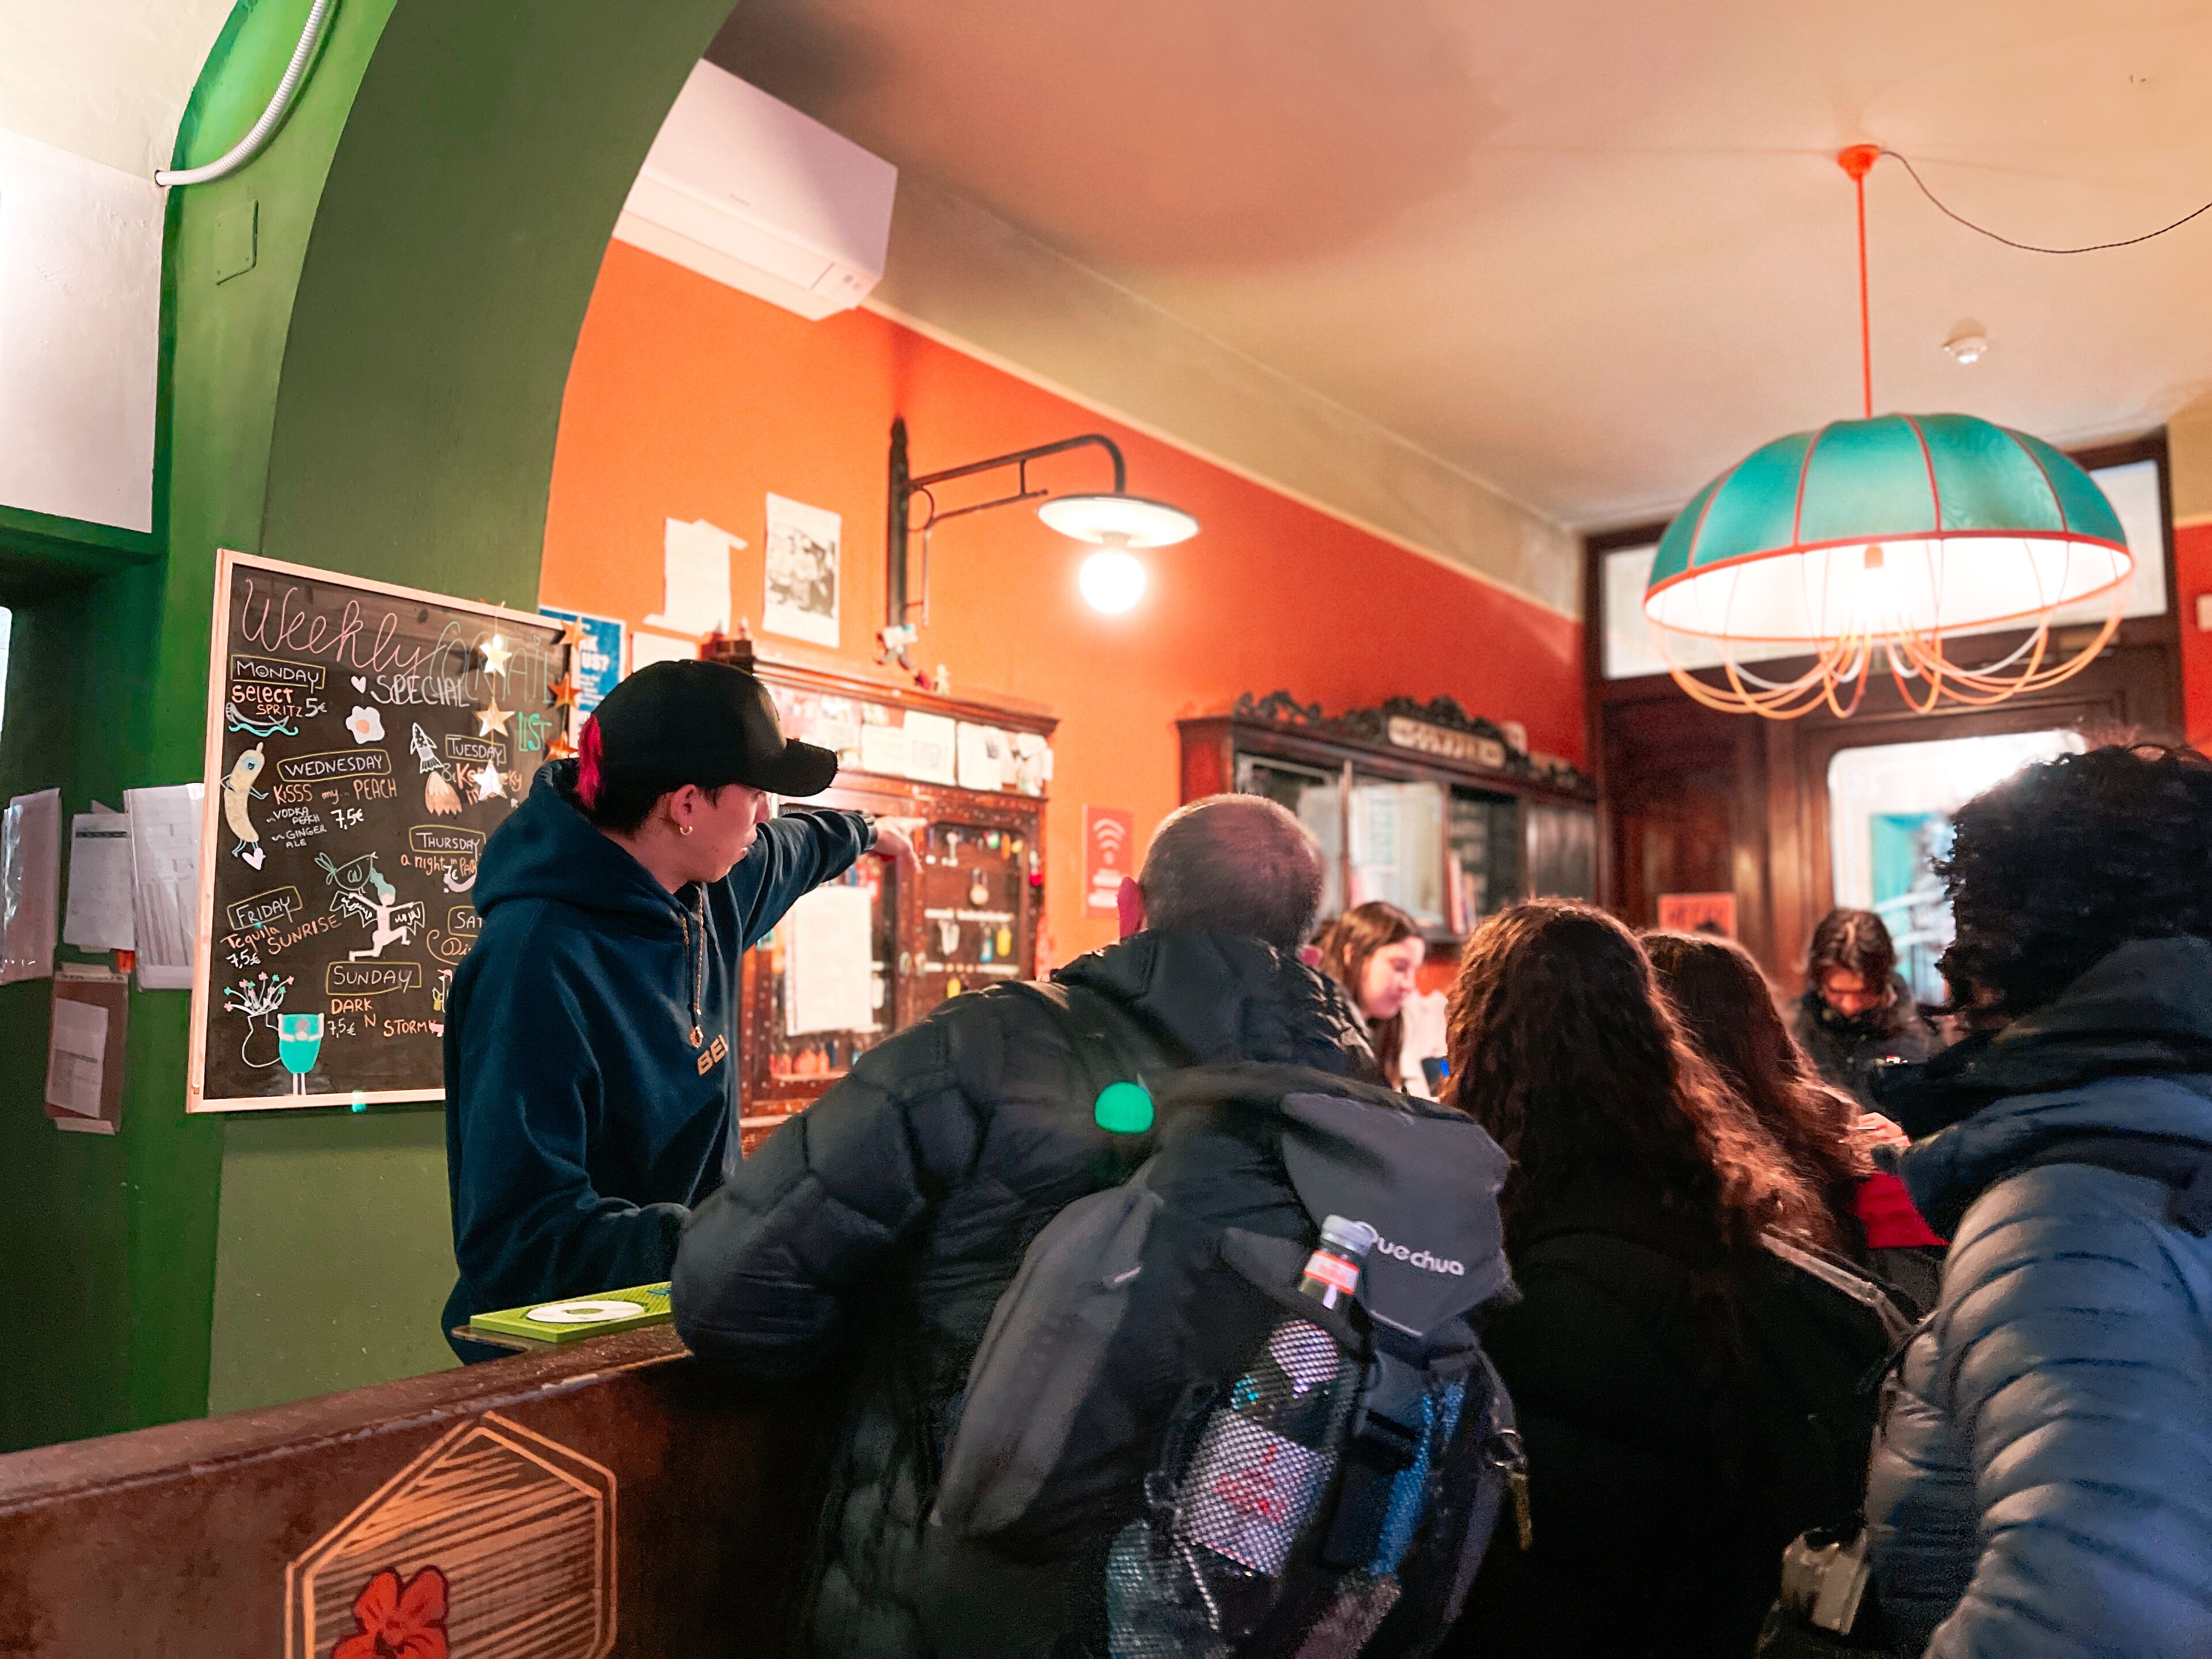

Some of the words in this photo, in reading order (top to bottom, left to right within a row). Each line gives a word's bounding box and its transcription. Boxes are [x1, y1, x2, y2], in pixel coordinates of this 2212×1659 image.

[243, 578, 446, 704] Weekly
[236, 660, 319, 694] MONDAY
[370, 674, 470, 707] SPECIAL
[256, 704, 302, 718] SPRITZ
[305, 698, 327, 717] 5€
[447, 737, 503, 766] TUESDAY
[285, 755, 382, 777] WEDNESDAY
[321, 789, 340, 805] my
[353, 778, 397, 800] PEACH
[272, 806, 309, 820] VODKA
[292, 813, 320, 825] PEACH
[331, 808, 364, 830] 7,5€
[286, 824, 328, 840] GINGER
[286, 839, 307, 849] ALE
[416, 832, 480, 861] THURSDAY
[236, 896, 293, 928] FRIDAY
[220, 925, 282, 953] Tequila
[267, 914, 342, 955] SUNRISE
[226, 948, 261, 969] 7,5€
[334, 965, 412, 994] SUNDAY
[331, 998, 373, 1015] DARK
[327, 1018, 357, 1038] 7,5€
[364, 1013, 376, 1028] N
